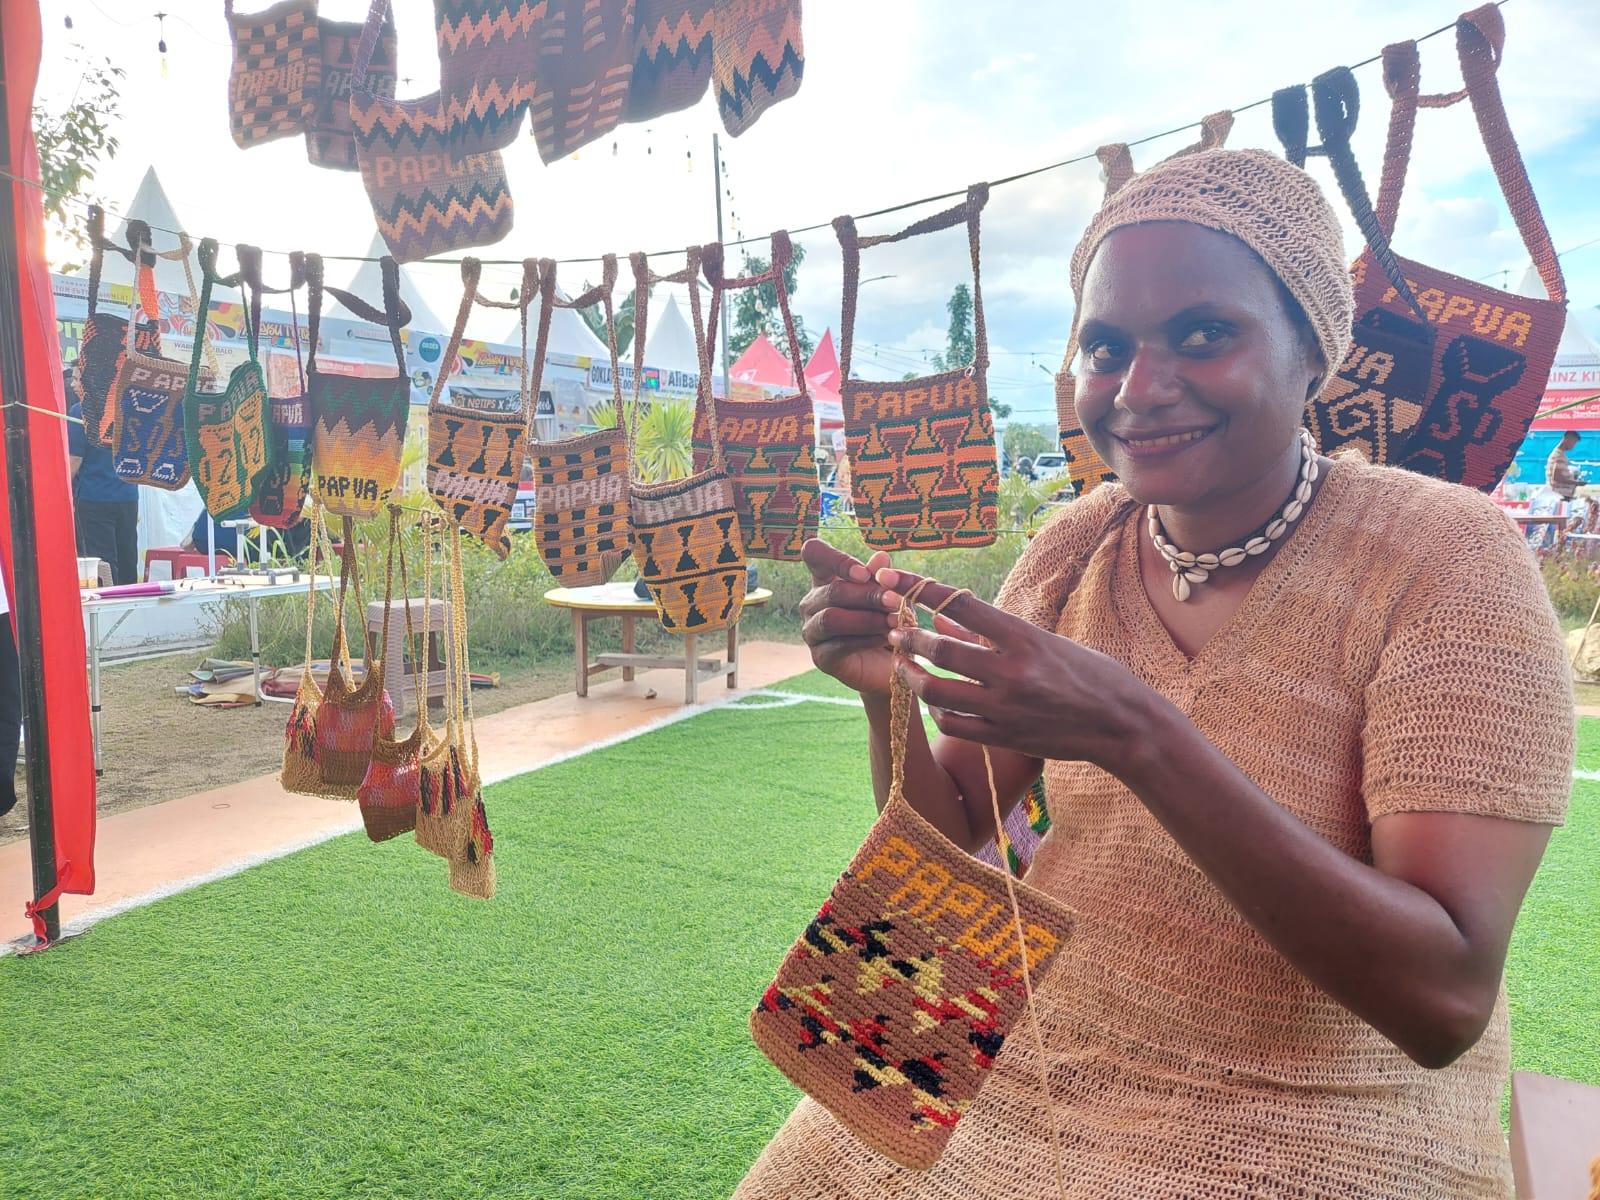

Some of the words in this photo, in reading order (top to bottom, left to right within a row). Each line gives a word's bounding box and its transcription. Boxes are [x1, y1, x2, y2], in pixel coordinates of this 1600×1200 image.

[237, 61, 305, 97] PAPUA
[853, 377, 978, 420] PAPUA
[318, 475, 377, 500] PAPUA
[537, 474, 623, 513] PAPUA
[857, 836, 1060, 979] PAPUA
